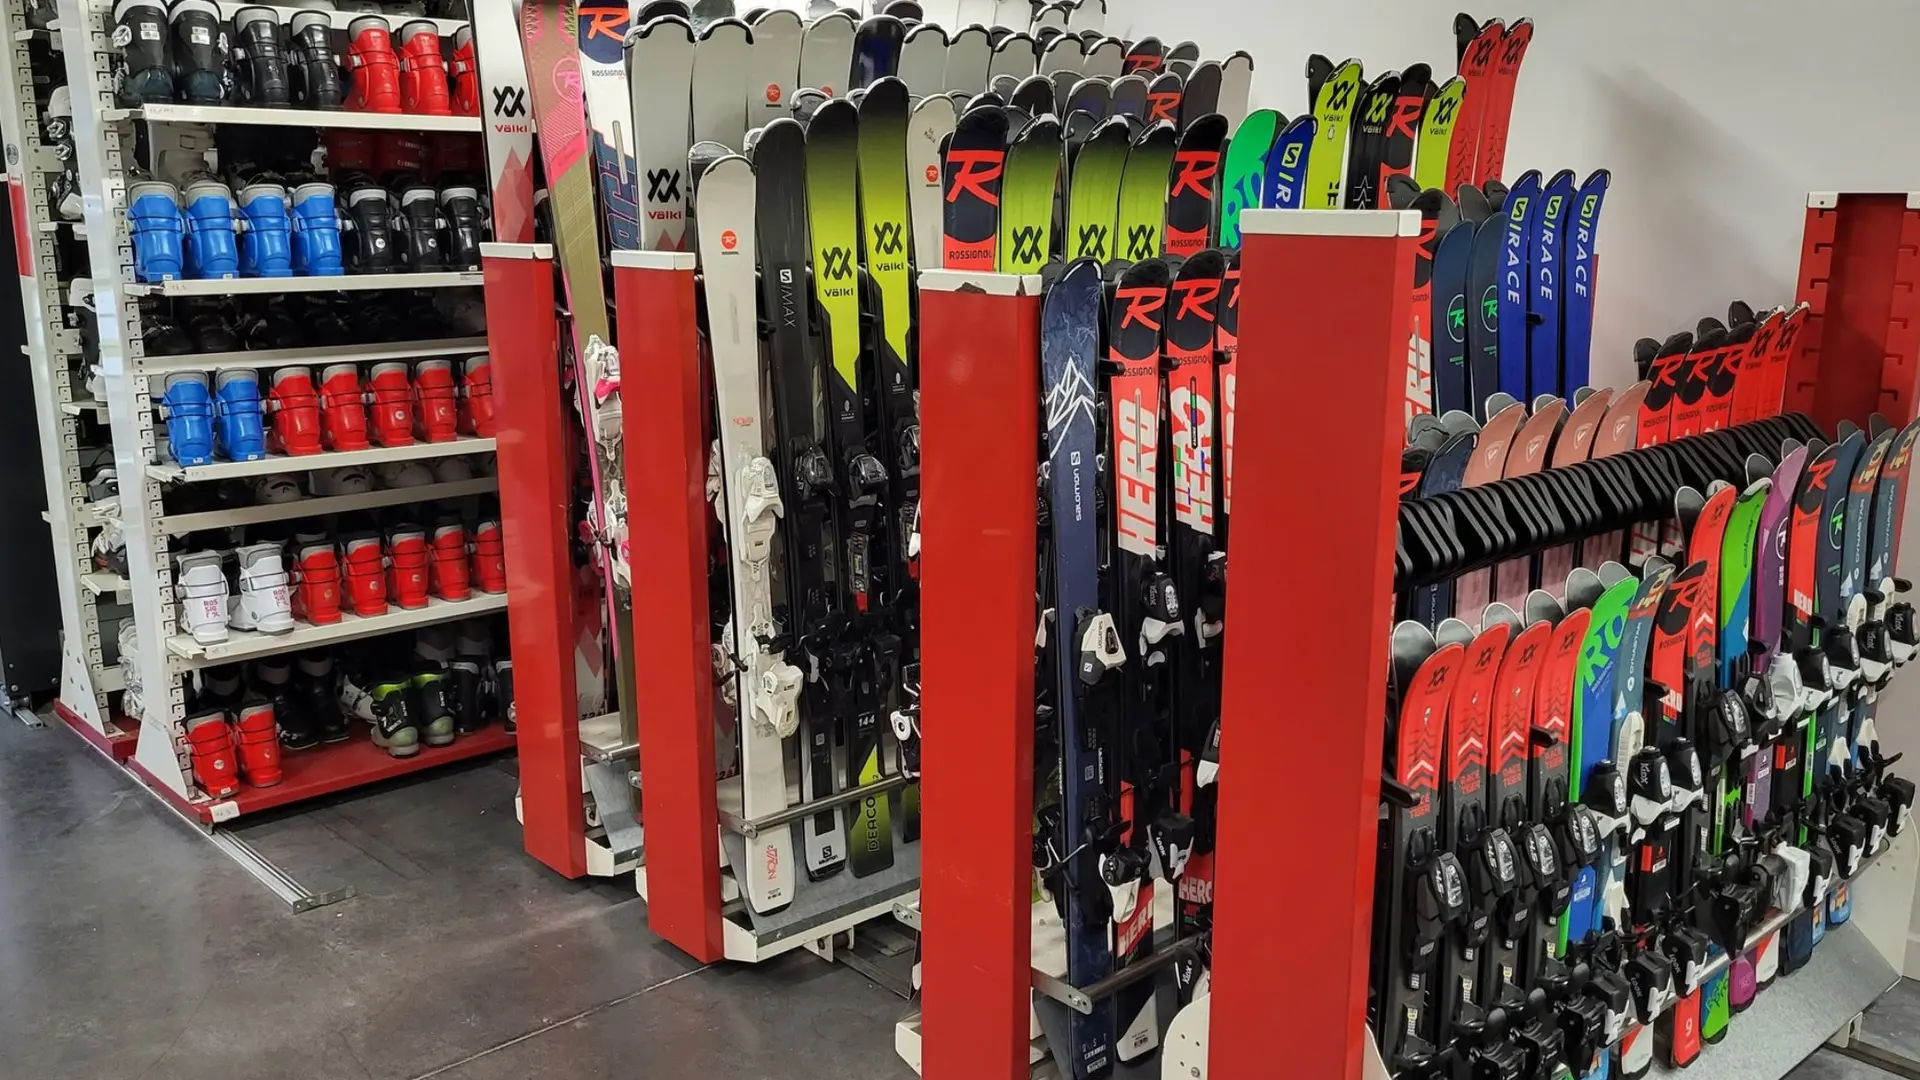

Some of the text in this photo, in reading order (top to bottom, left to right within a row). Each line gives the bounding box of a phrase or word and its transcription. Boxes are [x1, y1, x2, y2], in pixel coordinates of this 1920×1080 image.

[495, 123, 528, 133] Völkl
[648, 210, 682, 220] Völkl
[1170, 239, 1206, 249] ROSSIGNOL
[949, 250, 993, 261] ROSSIGNOL
[875, 261, 904, 272] Völkl
[824, 287, 854, 297] Völkl
[1629, 621, 1642, 675] DYNASTAR
[858, 714, 875, 728] 144
[866, 795, 879, 852] DEACO
[1155, 836, 1167, 858] LOOK
[1685, 1017, 1693, 1037] 9
